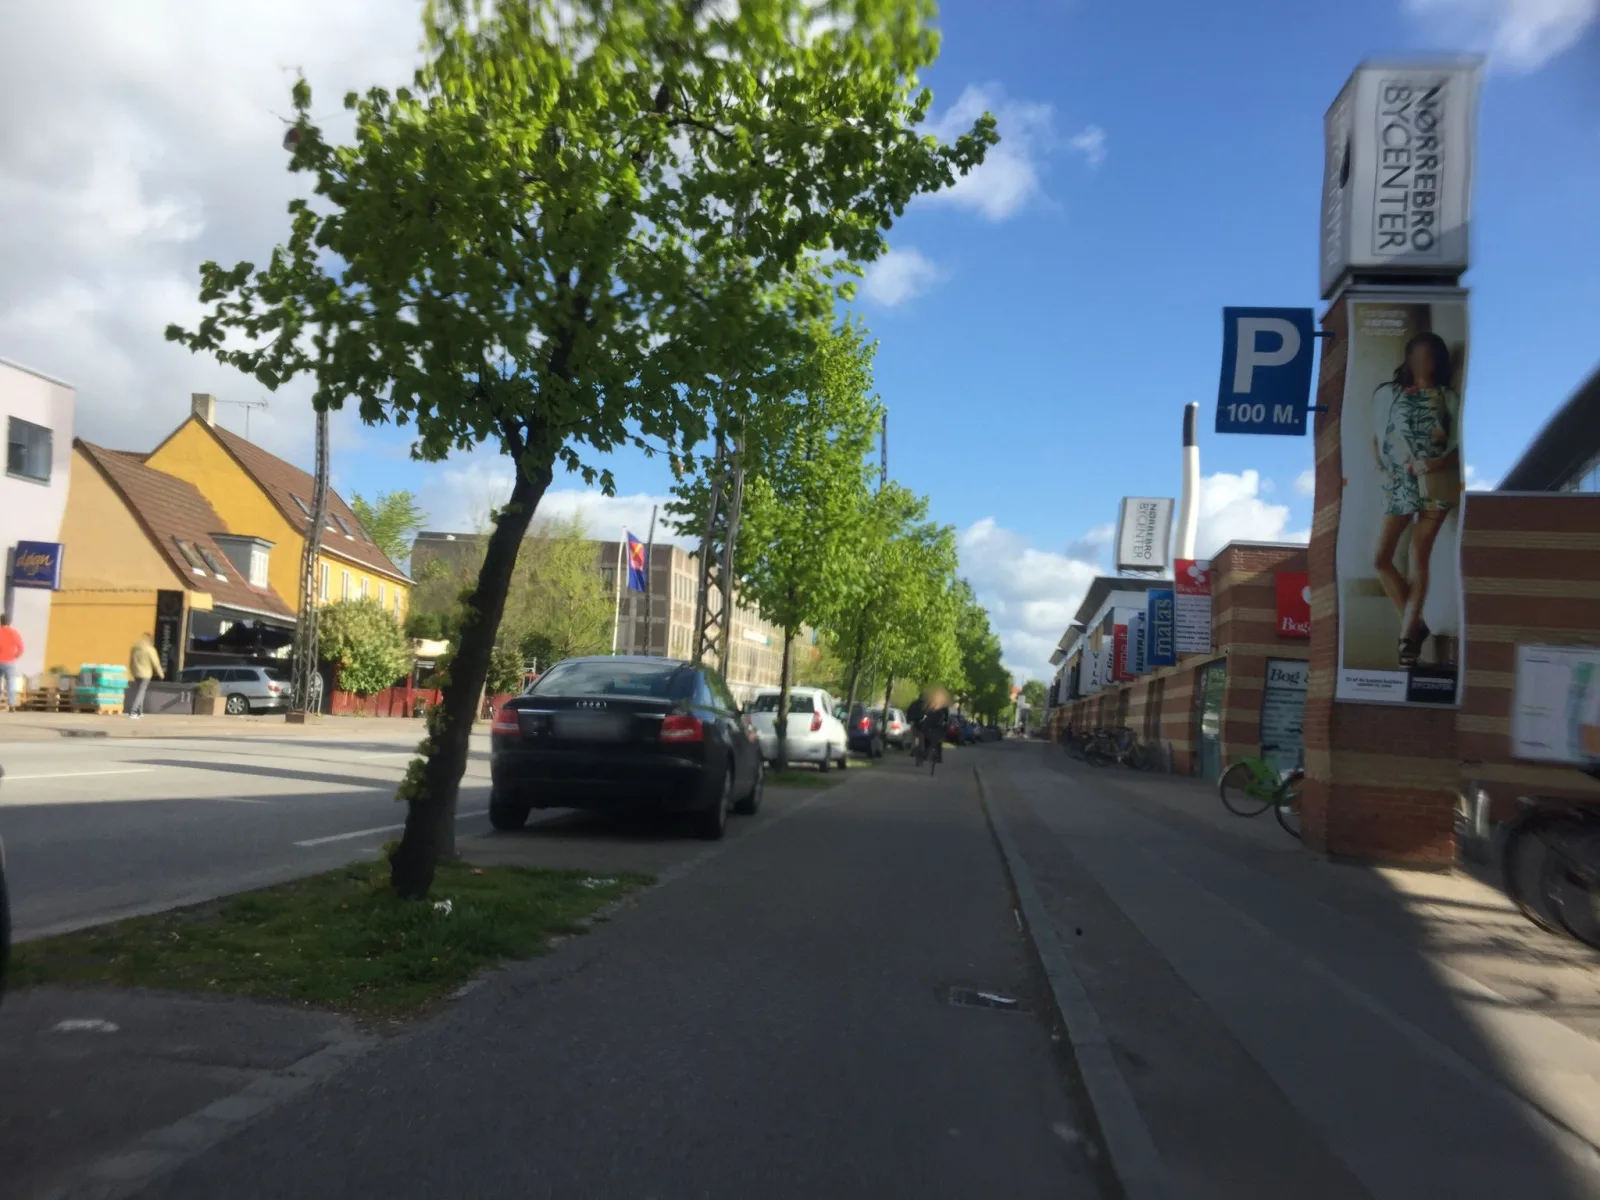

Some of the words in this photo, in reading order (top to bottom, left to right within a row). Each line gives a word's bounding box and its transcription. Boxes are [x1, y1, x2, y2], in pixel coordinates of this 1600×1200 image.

[1377, 83, 1412, 251] BYCENTER
[1410, 77, 1449, 252] NØRREBRO
[1233, 317, 1301, 394] P
[1227, 402, 1266, 423] 100
[1272, 404, 1299, 424] M.
[1153, 599, 1173, 657] matas
[1091, 652, 1099, 686] VILA
[1270, 668, 1301, 686] Bog
